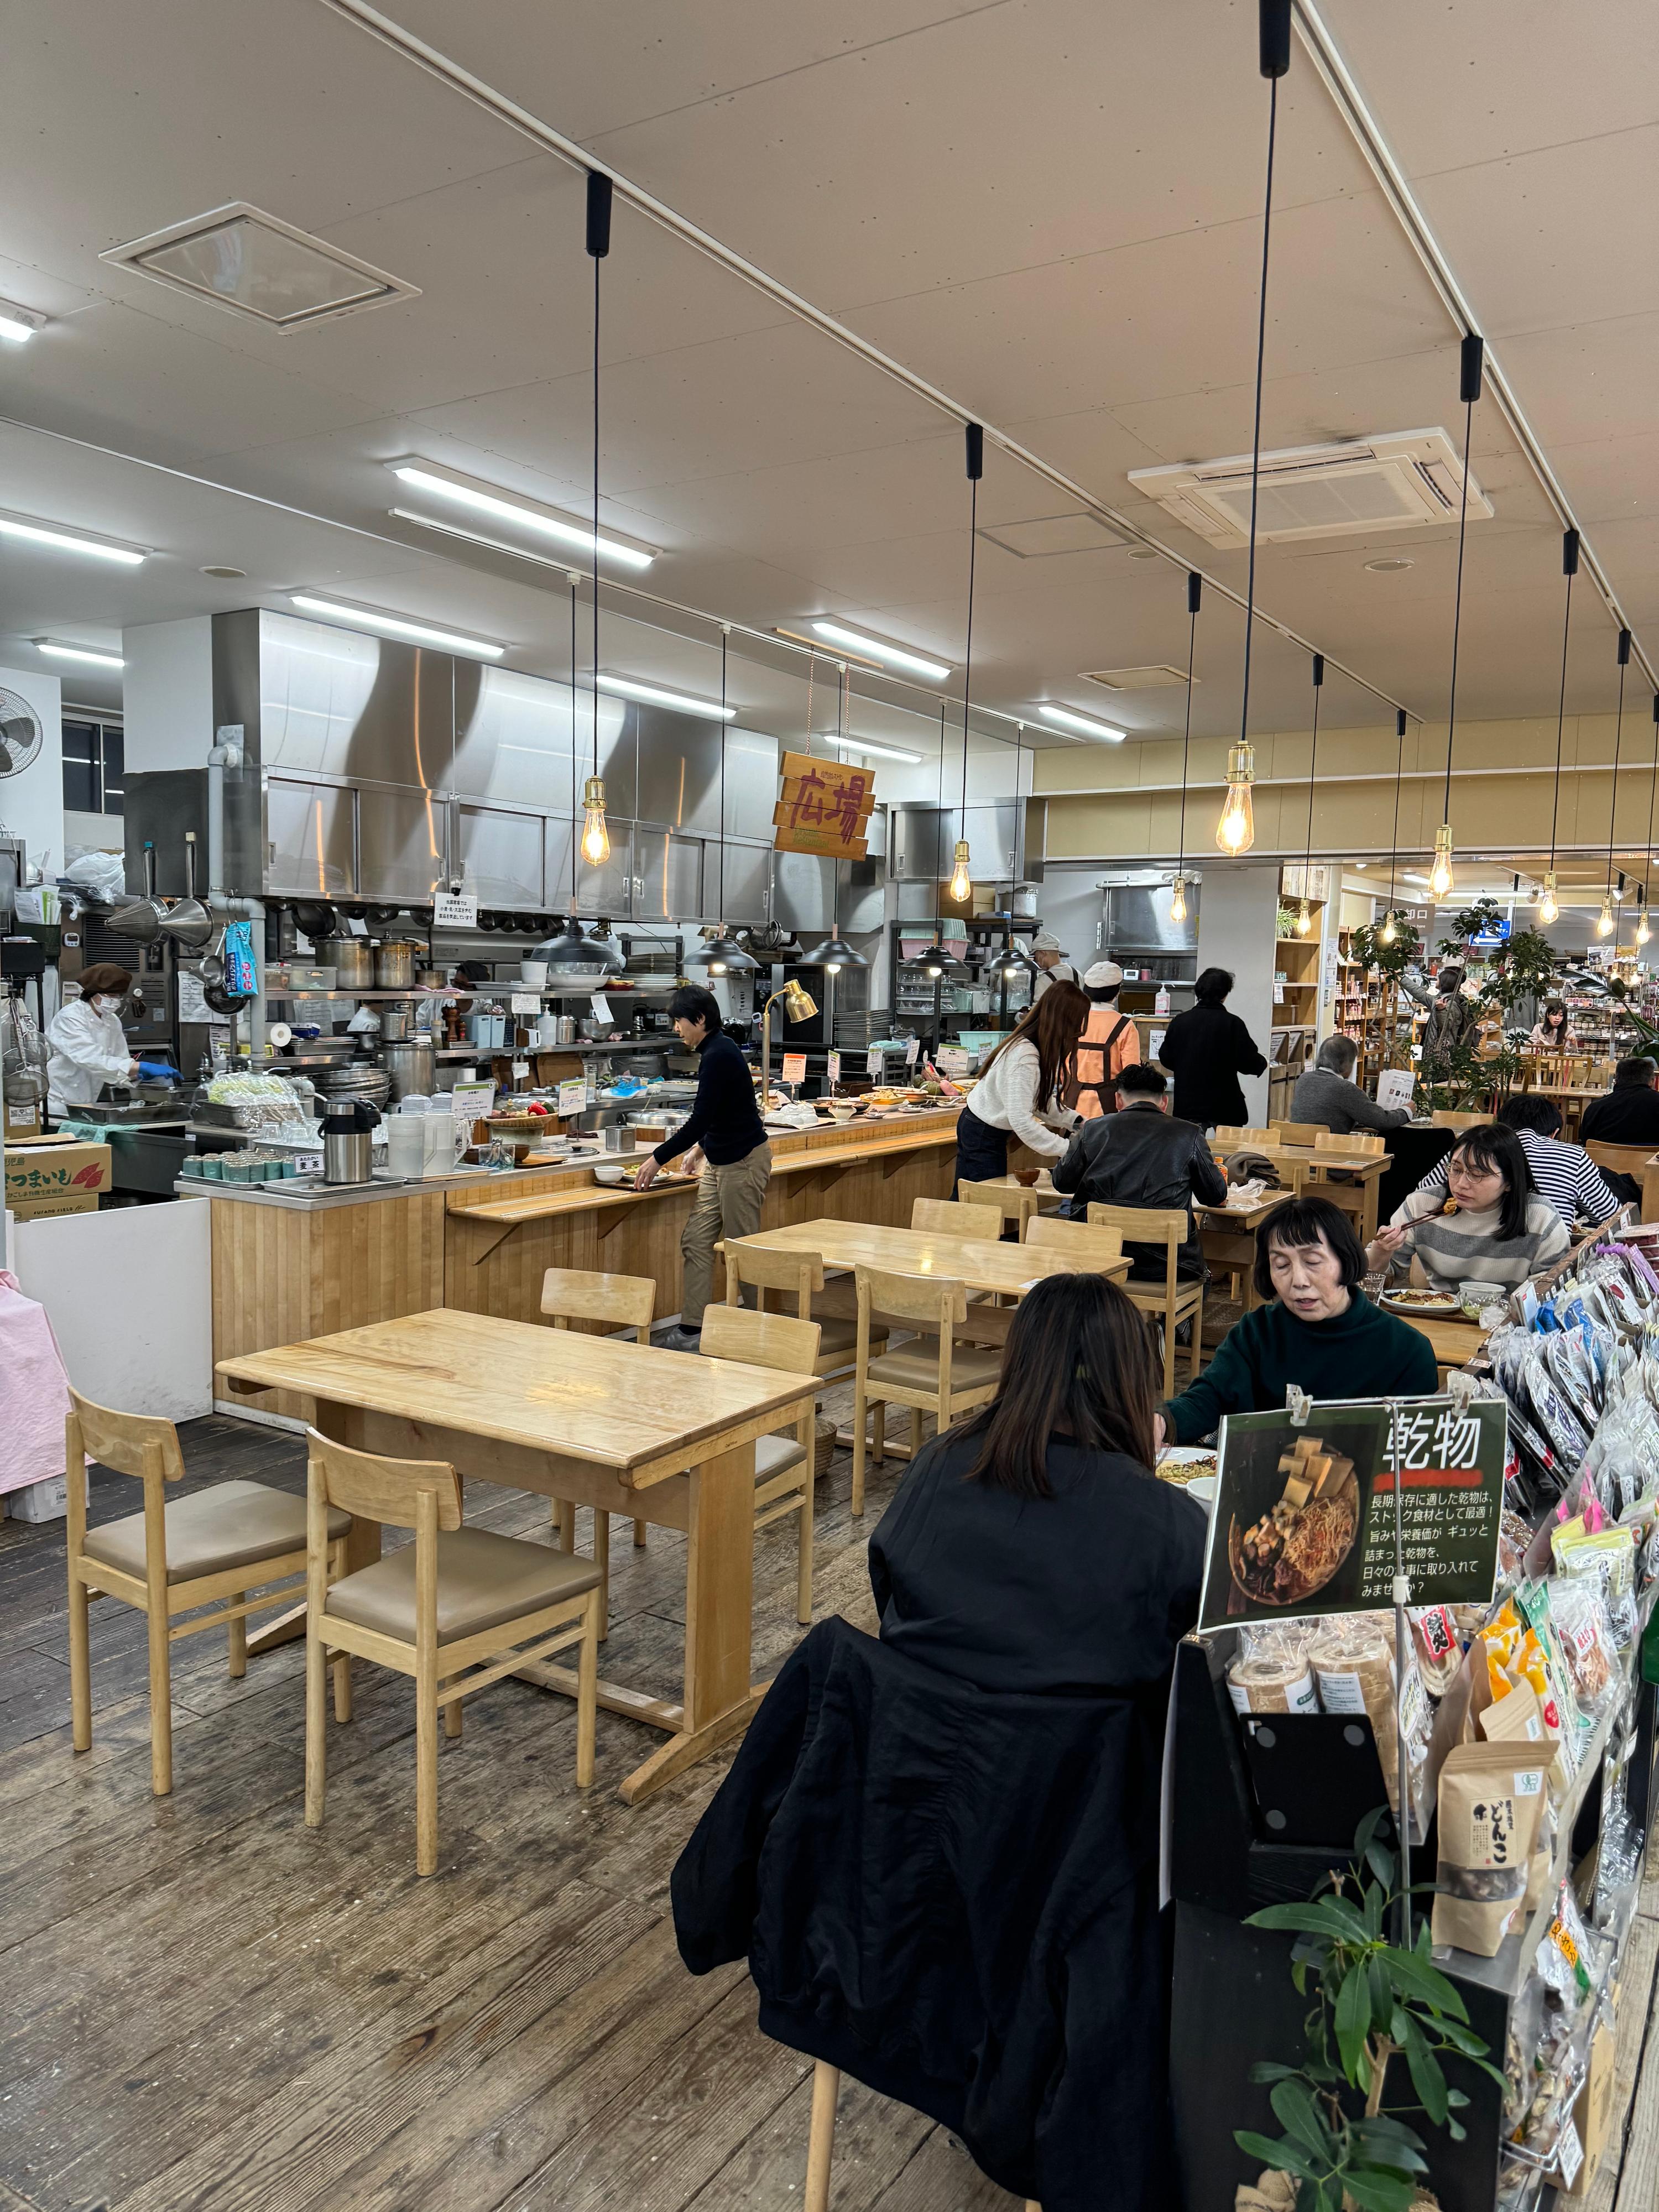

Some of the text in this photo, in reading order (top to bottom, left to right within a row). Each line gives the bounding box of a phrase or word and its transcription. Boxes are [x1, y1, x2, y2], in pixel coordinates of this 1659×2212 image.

[790, 768, 865, 846] 広場
[1382, 1410, 1481, 1472] 乾物
[1369, 1505, 1493, 1524] ストク食材として最適！
[1447, 1524, 1489, 1538] ギュッと
[1361, 1582, 1425, 1598] みませか？
[1490, 1800, 1507, 1864] どんこ
